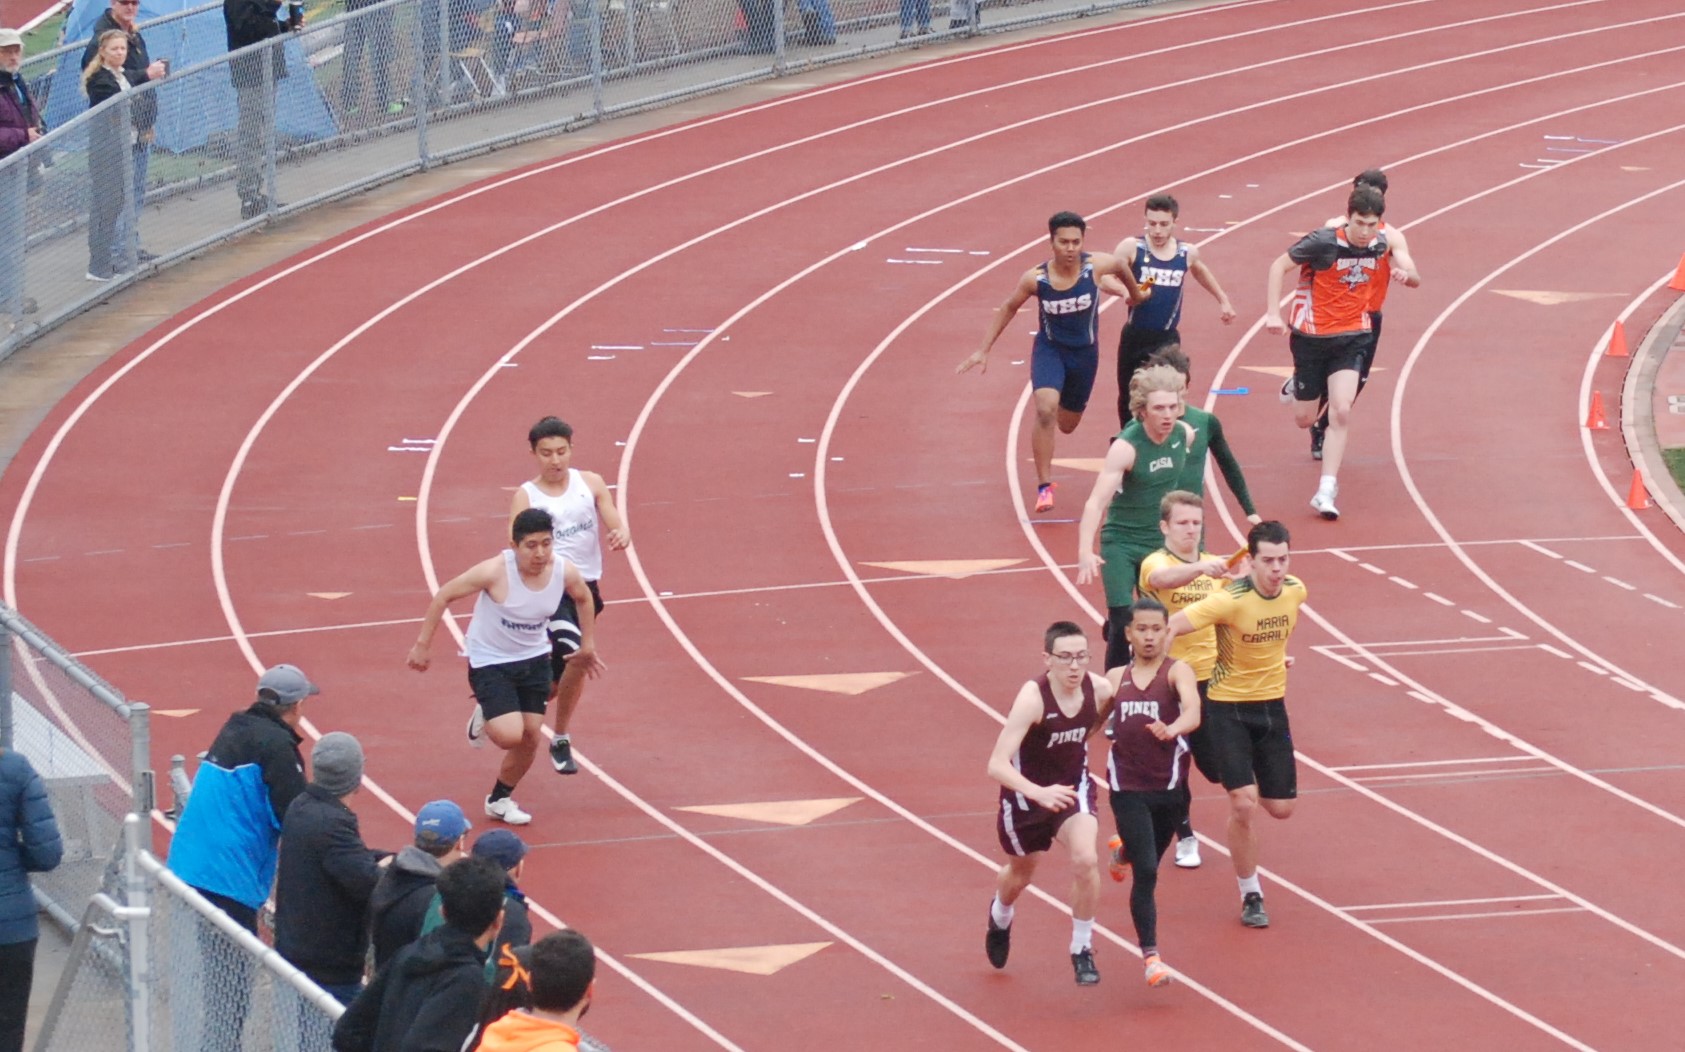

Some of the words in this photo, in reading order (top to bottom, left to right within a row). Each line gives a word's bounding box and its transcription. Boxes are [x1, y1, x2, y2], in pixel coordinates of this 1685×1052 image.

[1140, 266, 1184, 287] NHS
[1042, 293, 1092, 315] NHS
[1149, 457, 1174, 473] CASA
[1257, 614, 1289, 631] MARIA
[1120, 701, 1160, 723] PINER
[1046, 727, 1087, 749] PINER
